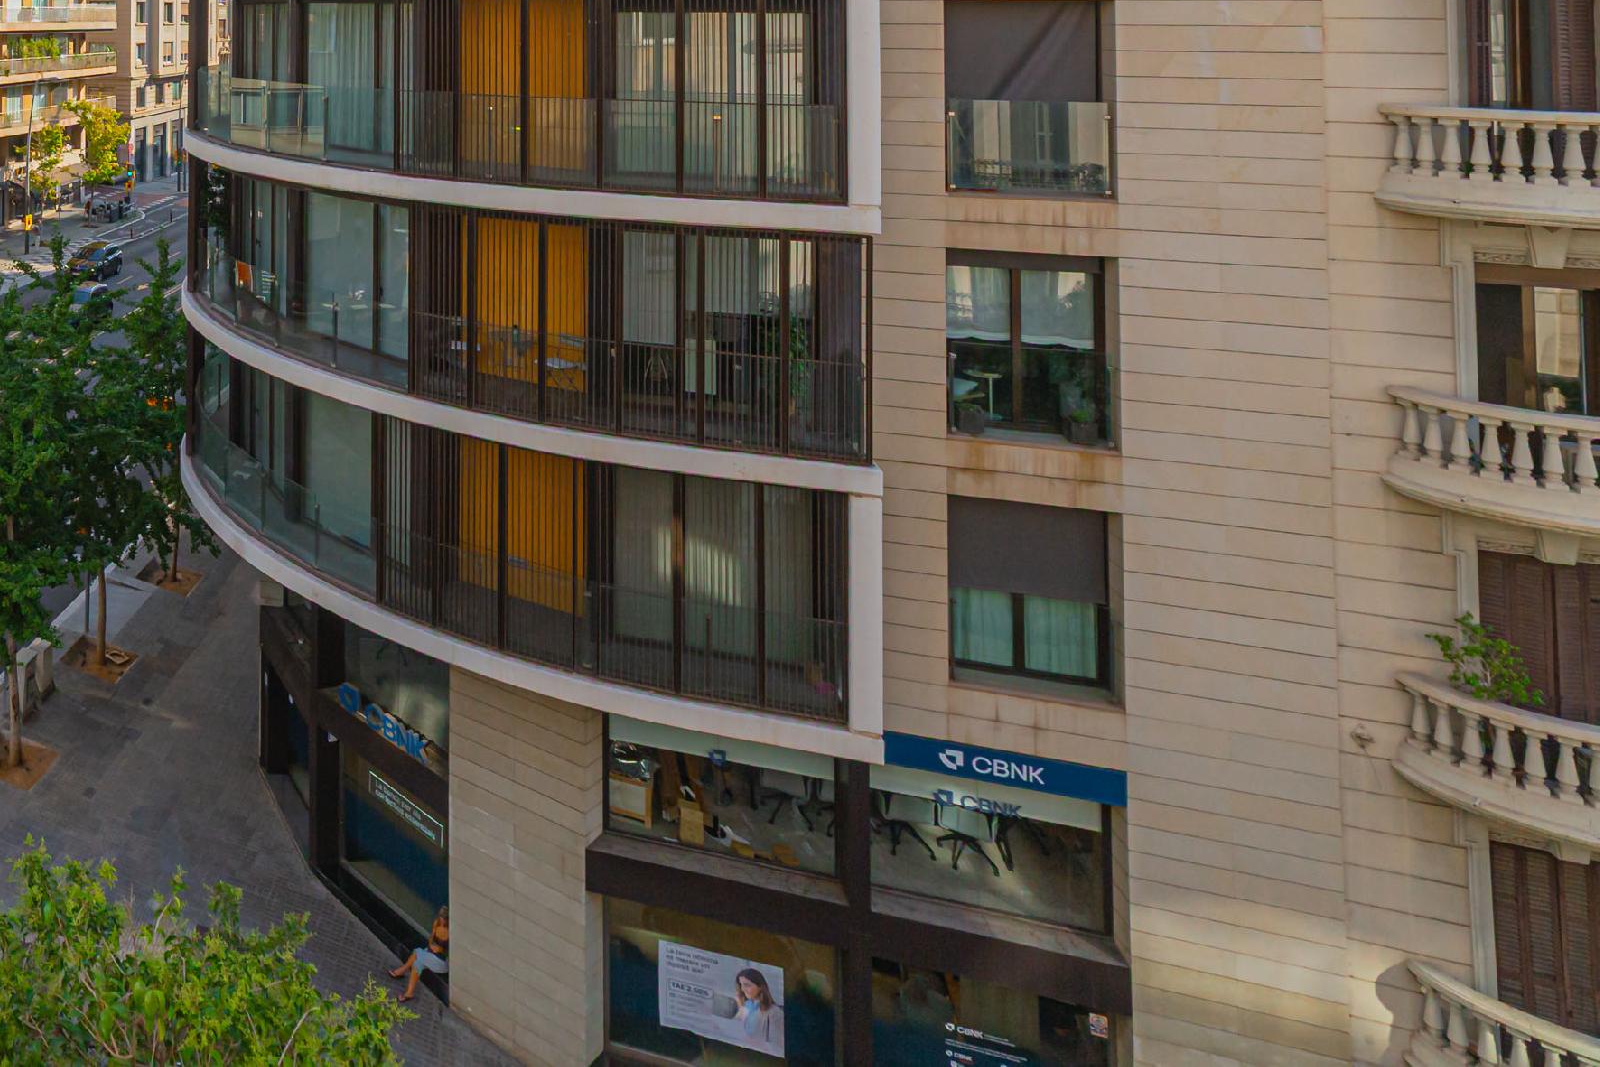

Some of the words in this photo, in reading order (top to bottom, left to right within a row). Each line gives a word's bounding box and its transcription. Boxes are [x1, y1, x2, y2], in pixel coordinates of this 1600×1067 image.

[364, 703, 430, 765] CBNK
[972, 756, 1045, 785] CBNK
[960, 795, 1022, 820] CBNK
[956, 1026, 984, 1040] CBNK
